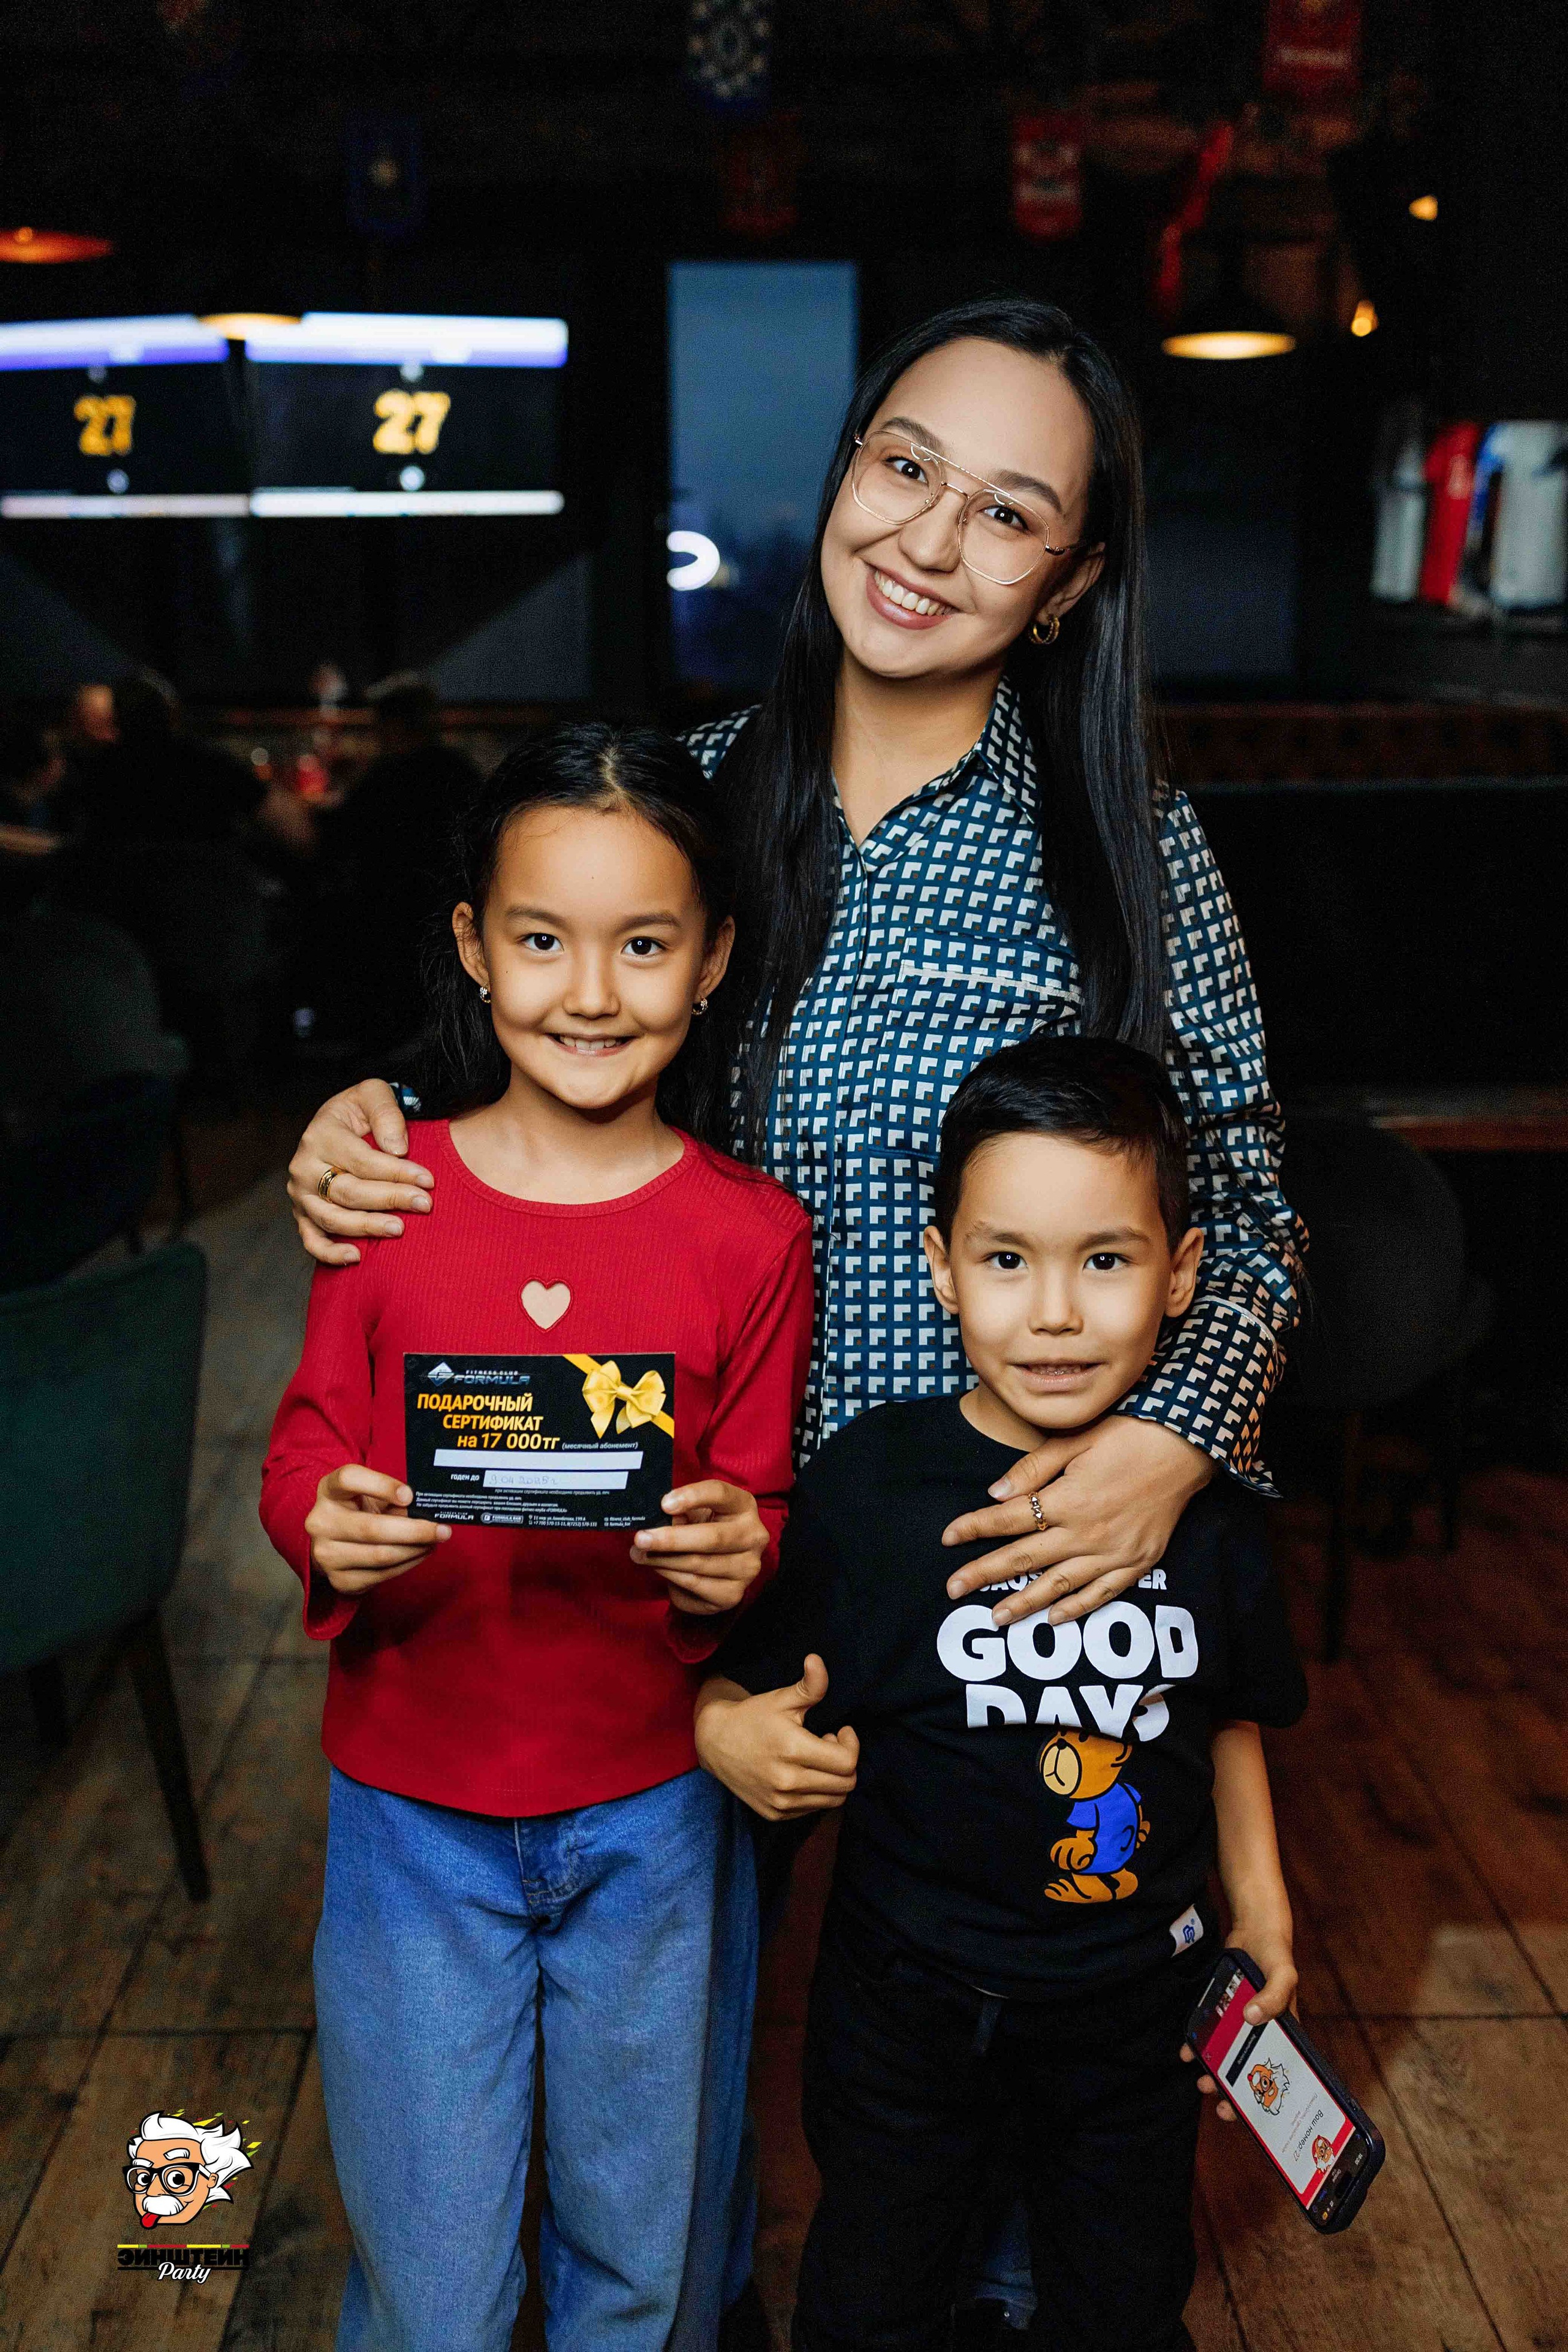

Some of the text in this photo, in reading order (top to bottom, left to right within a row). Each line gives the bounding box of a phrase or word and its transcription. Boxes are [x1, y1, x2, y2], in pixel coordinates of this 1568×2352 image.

[74, 394, 136, 456] 27
[372, 389, 451, 454] 27
[453, 1375, 530, 1385] FORMULA
[417, 1393, 533, 1412] ПОДАРОЧНЫЙ
[443, 1414, 544, 1431] СЕРТИФИКАТ
[457, 1435, 478, 1448] на
[481, 1433, 502, 1448] 17
[937, 1601, 1199, 1681] GOOD
[966, 1684, 1175, 1741] DAYS
[1310, 2109, 1324, 2128] Ваш
[1297, 2125, 1313, 2151] номер:
